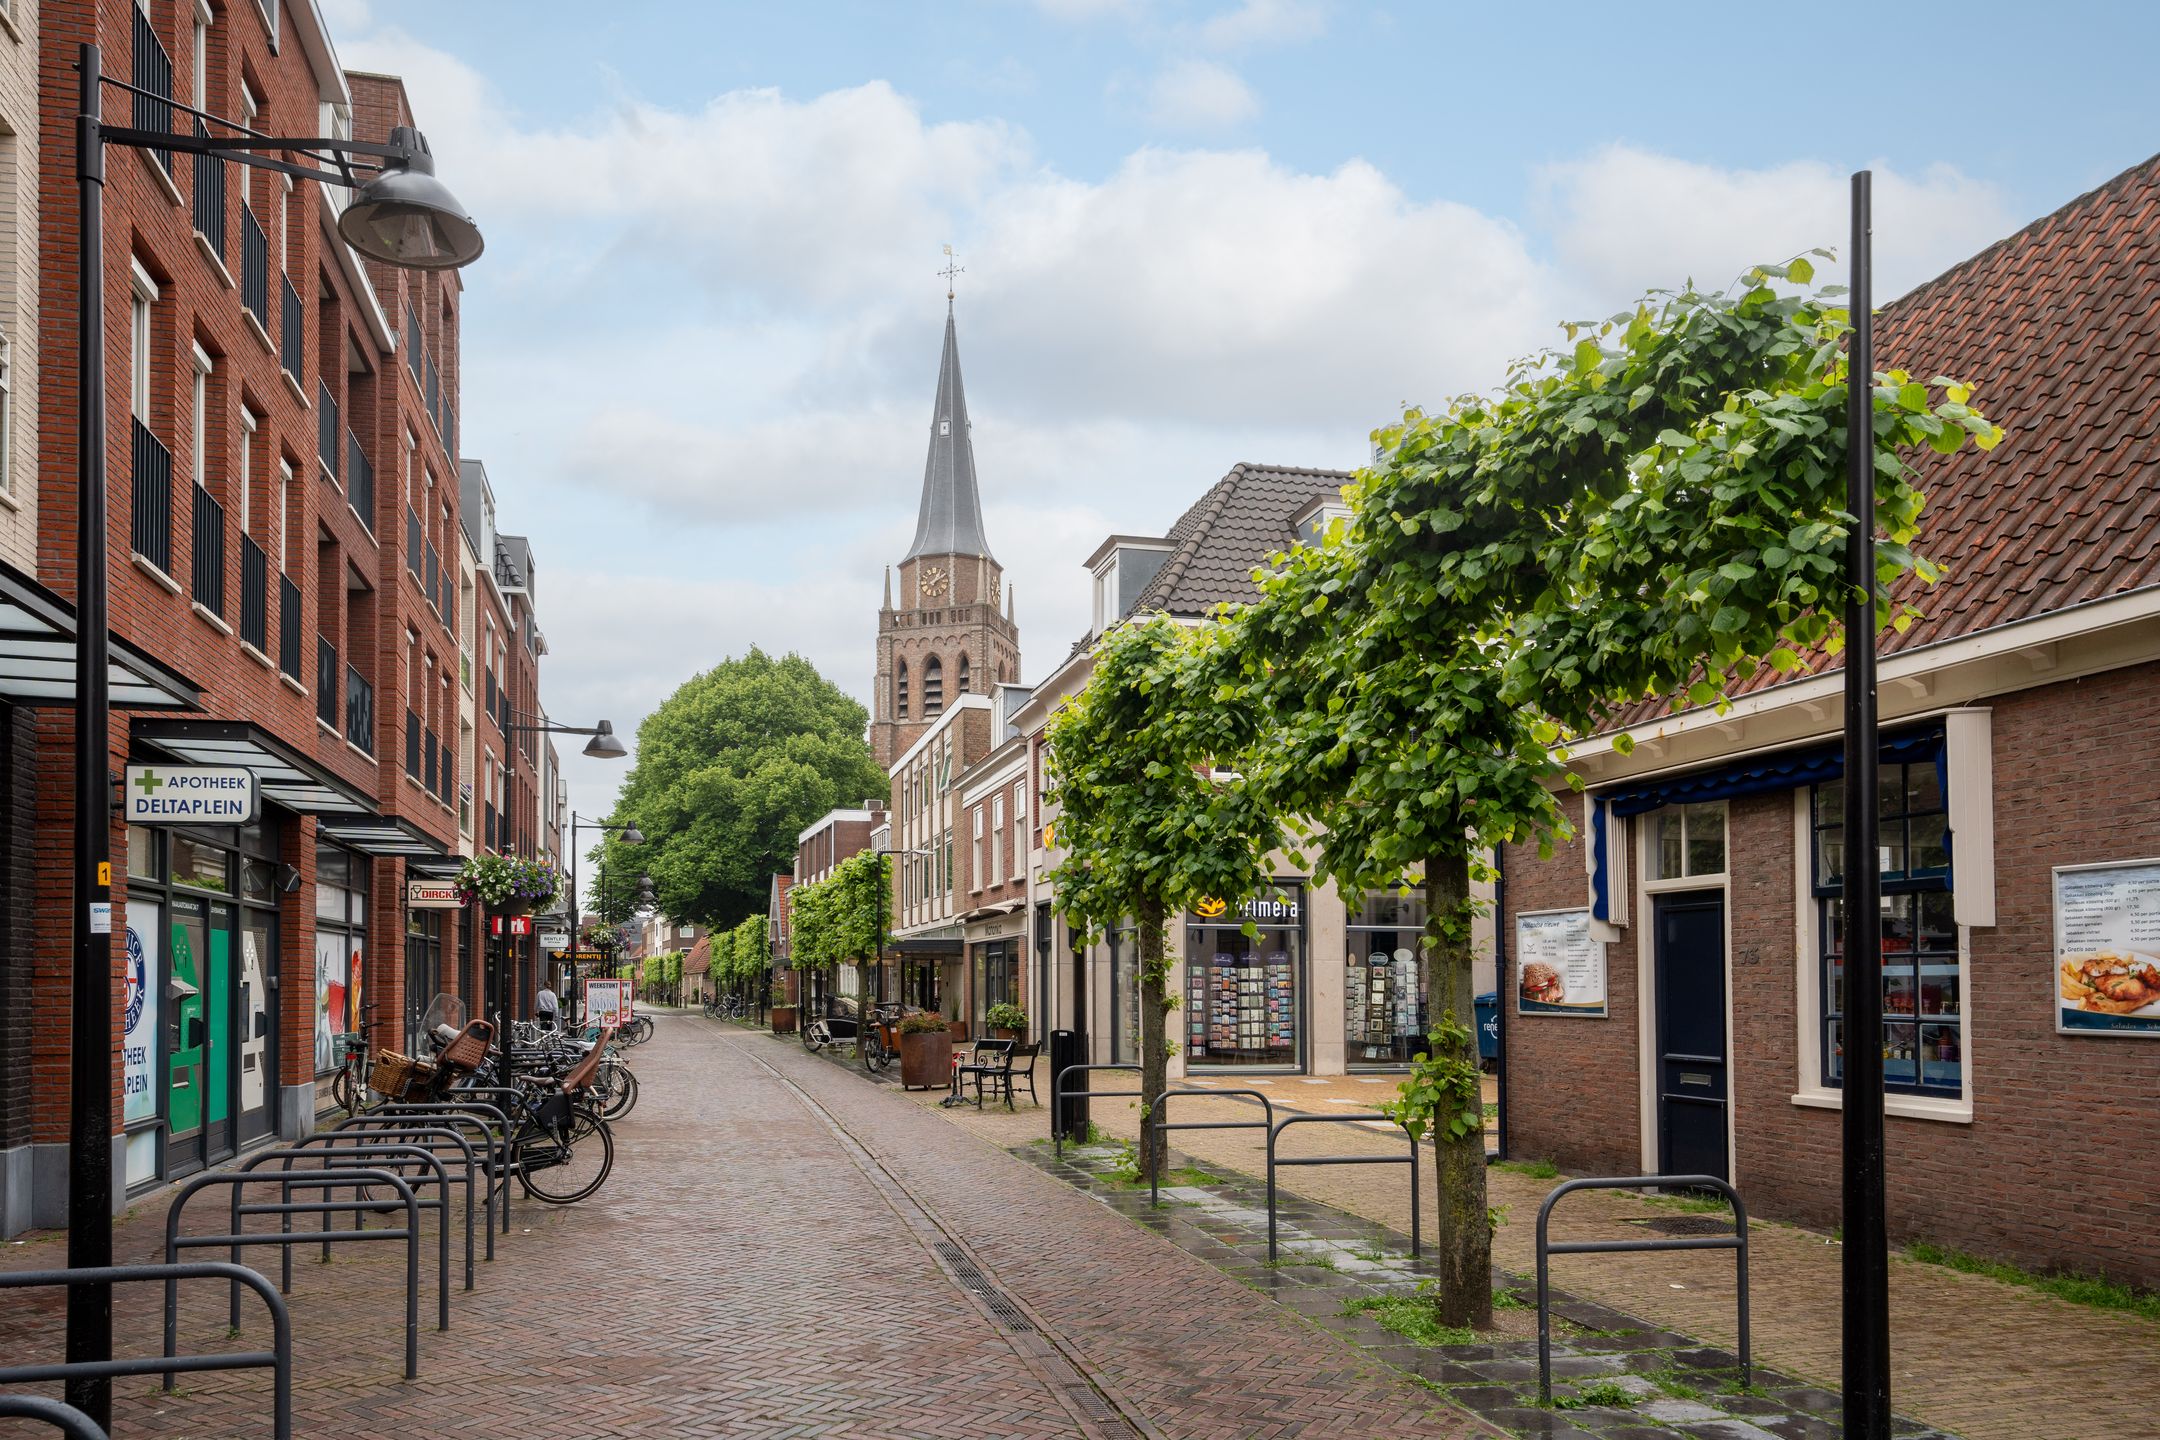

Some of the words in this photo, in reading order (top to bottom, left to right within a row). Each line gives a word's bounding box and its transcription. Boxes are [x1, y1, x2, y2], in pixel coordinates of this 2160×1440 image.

[168, 776, 246, 790] APOTHEEK
[136, 798, 243, 815] DELTAPLEIN
[101, 867, 108, 882] 1
[422, 890, 452, 899] DIRCK
[1236, 896, 1298, 917] rimera
[123, 1046, 146, 1066] THEEK
